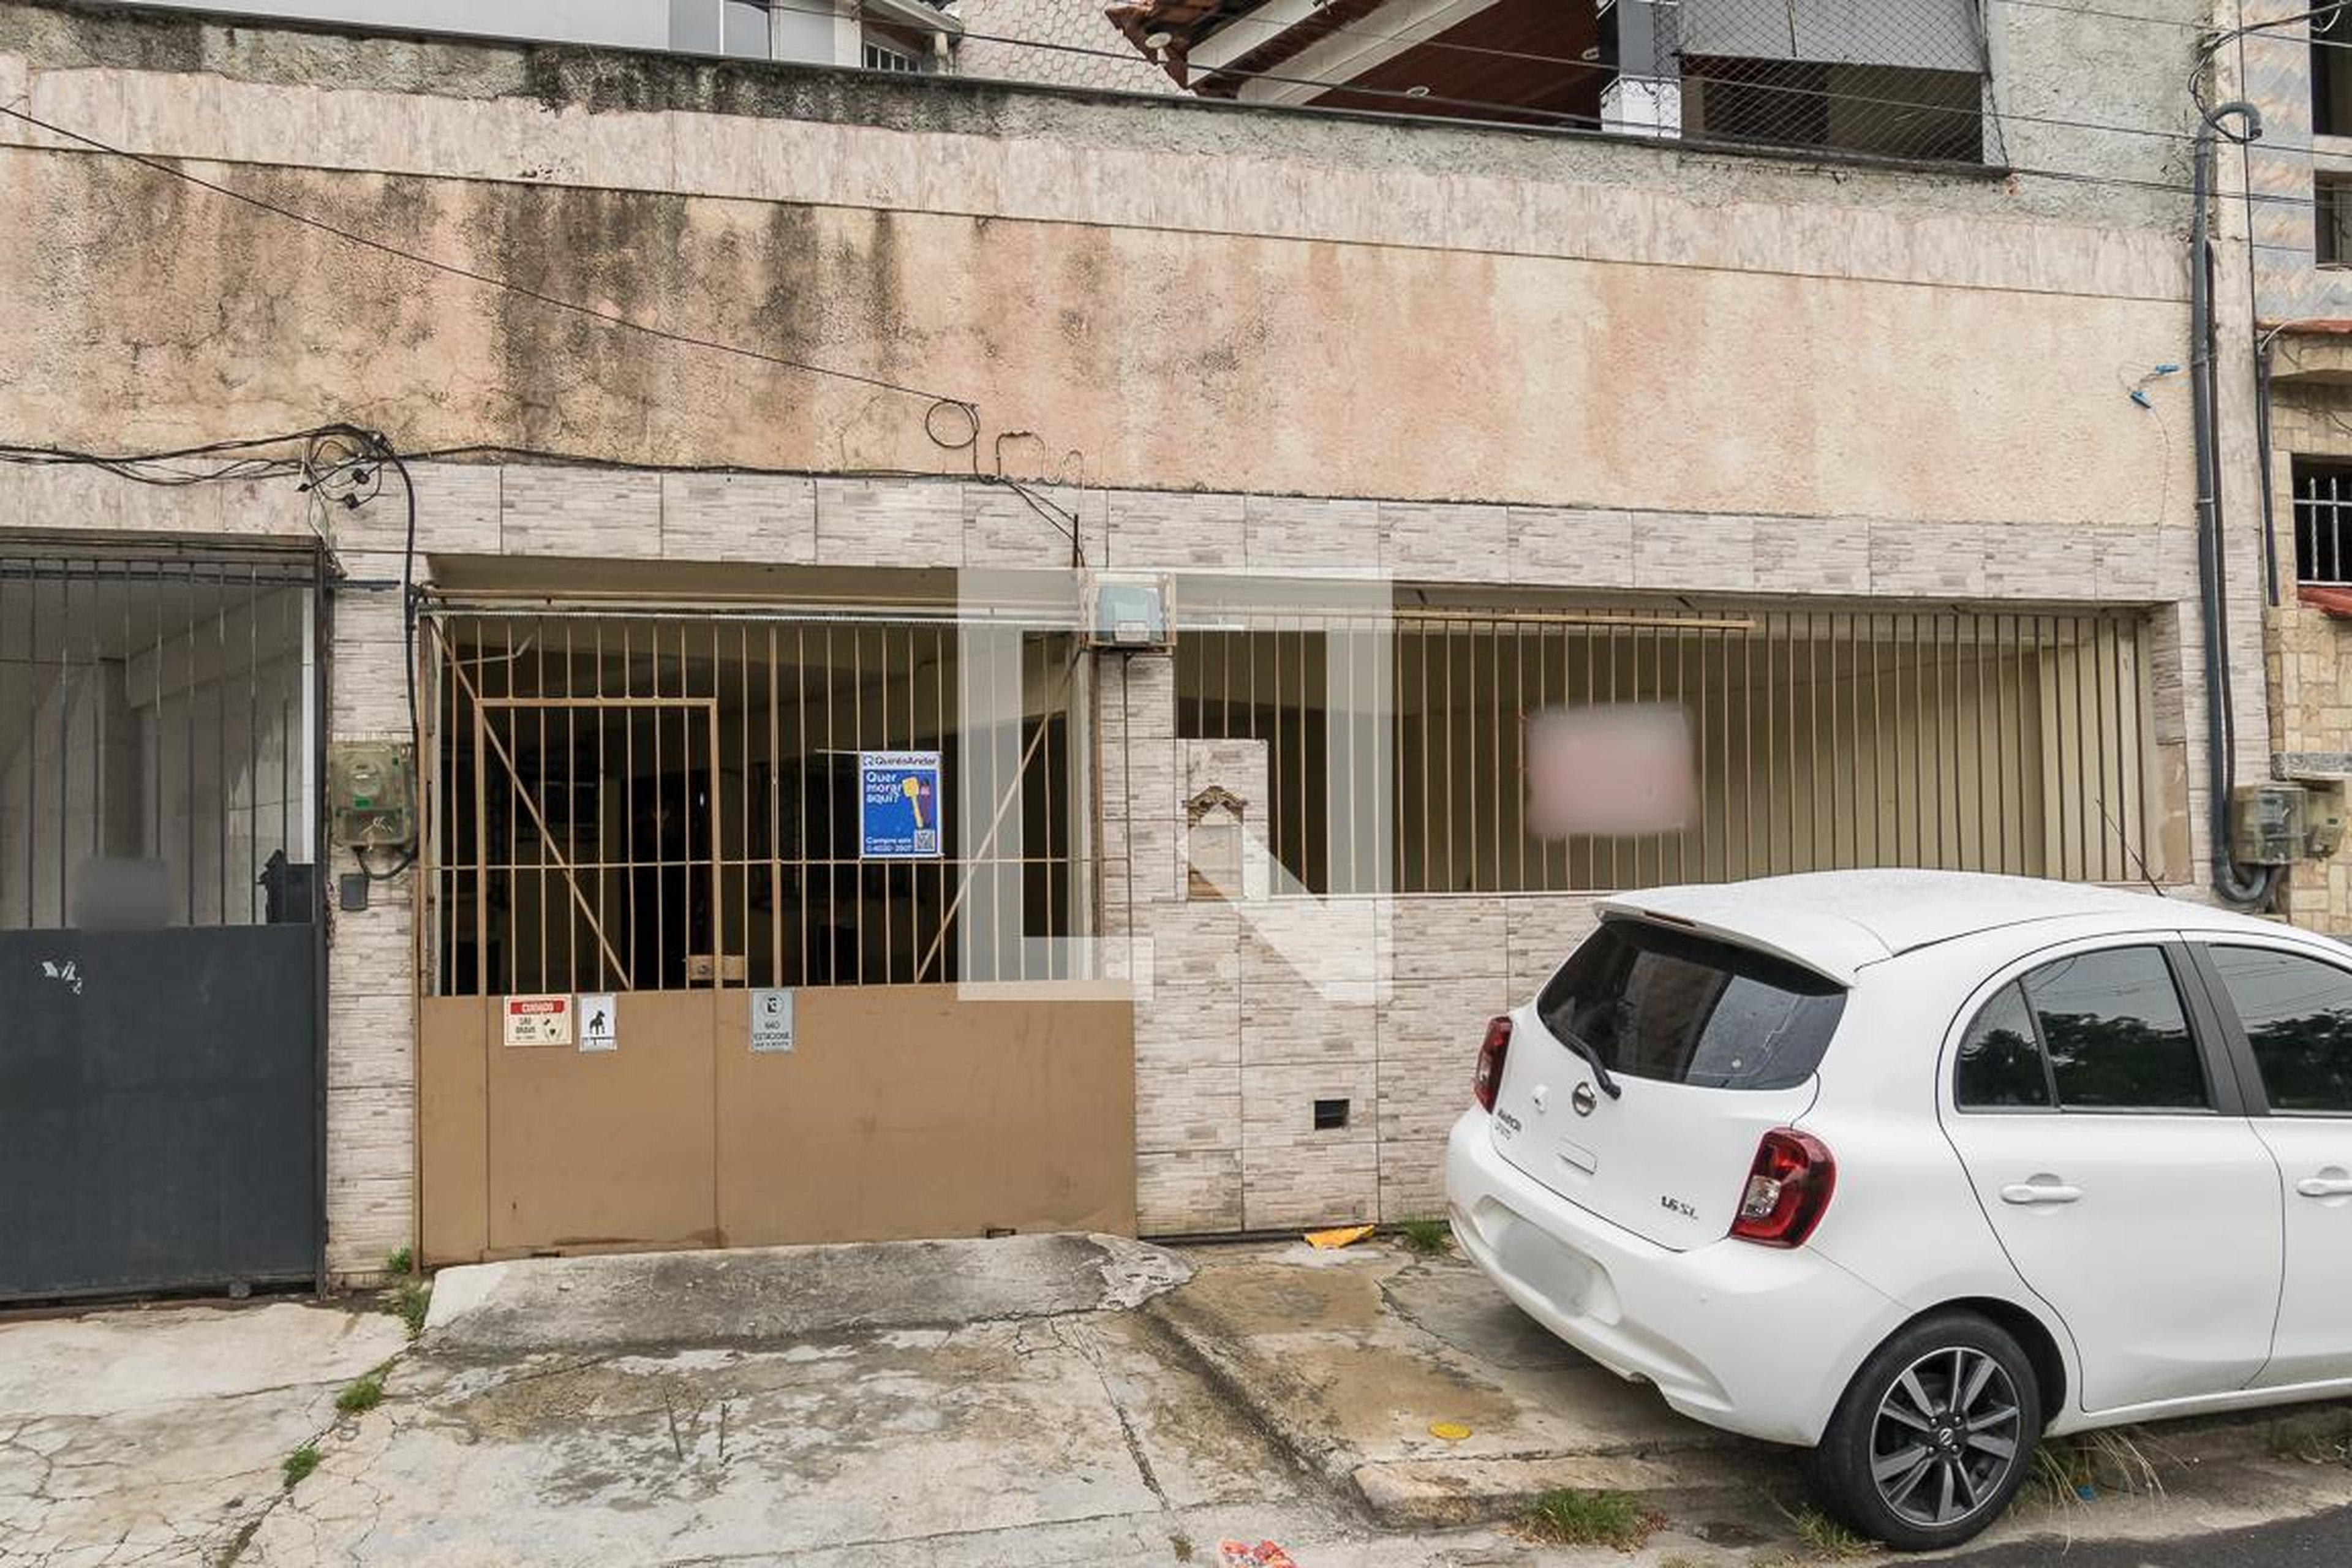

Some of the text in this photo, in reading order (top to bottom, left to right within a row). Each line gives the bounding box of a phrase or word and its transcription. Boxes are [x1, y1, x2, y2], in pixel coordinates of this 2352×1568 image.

[866, 771, 897, 783] Quer
[865, 783, 902, 793] morar
[865, 793, 899, 804] aqui?
